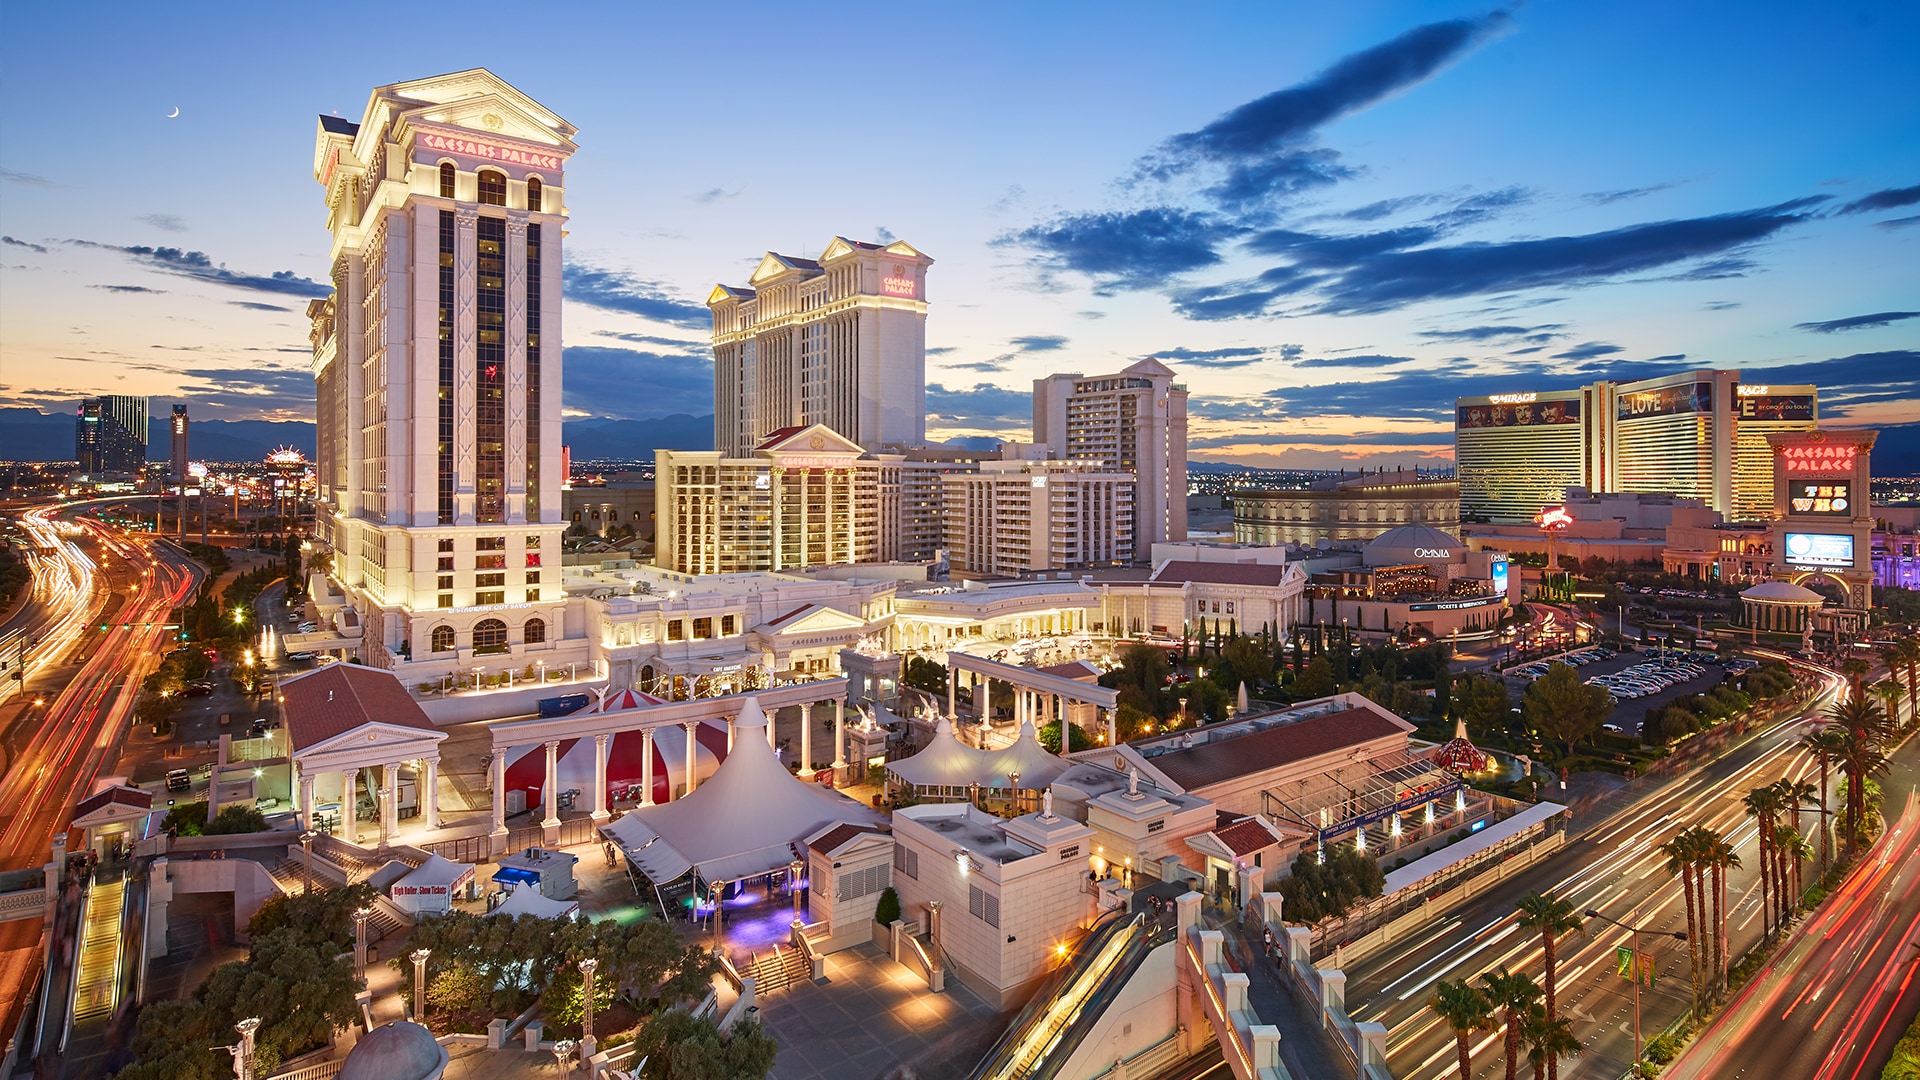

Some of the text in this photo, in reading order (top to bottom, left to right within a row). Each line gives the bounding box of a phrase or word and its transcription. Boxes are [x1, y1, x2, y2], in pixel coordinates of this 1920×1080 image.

[424, 135, 557, 169] CAESARS PALACE
[883, 277, 915, 288] CAESARS
[885, 285, 913, 295] PALACE
[1500, 392, 1537, 403] MIRAGE
[1631, 393, 1662, 414] LOVE
[1783, 447, 1856, 459] CAESARS
[781, 457, 853, 466] CAESARS PALACE
[1787, 459, 1853, 471] PALACE
[1804, 486, 1847, 498] THE
[1792, 498, 1848, 512] WHO
[1414, 547, 1450, 558] OMNIA
[1490, 553, 1507, 562] OMNIA
[791, 634, 852, 646] CAESARS PALACE
[1147, 819, 1164, 828] CAESARS
[1148, 825, 1164, 833] PALACE
[1060, 845, 1079, 854] CAESARS
[1061, 850, 1078, 860] PALACE
[394, 886, 447, 896] High Roller Show Tickets
